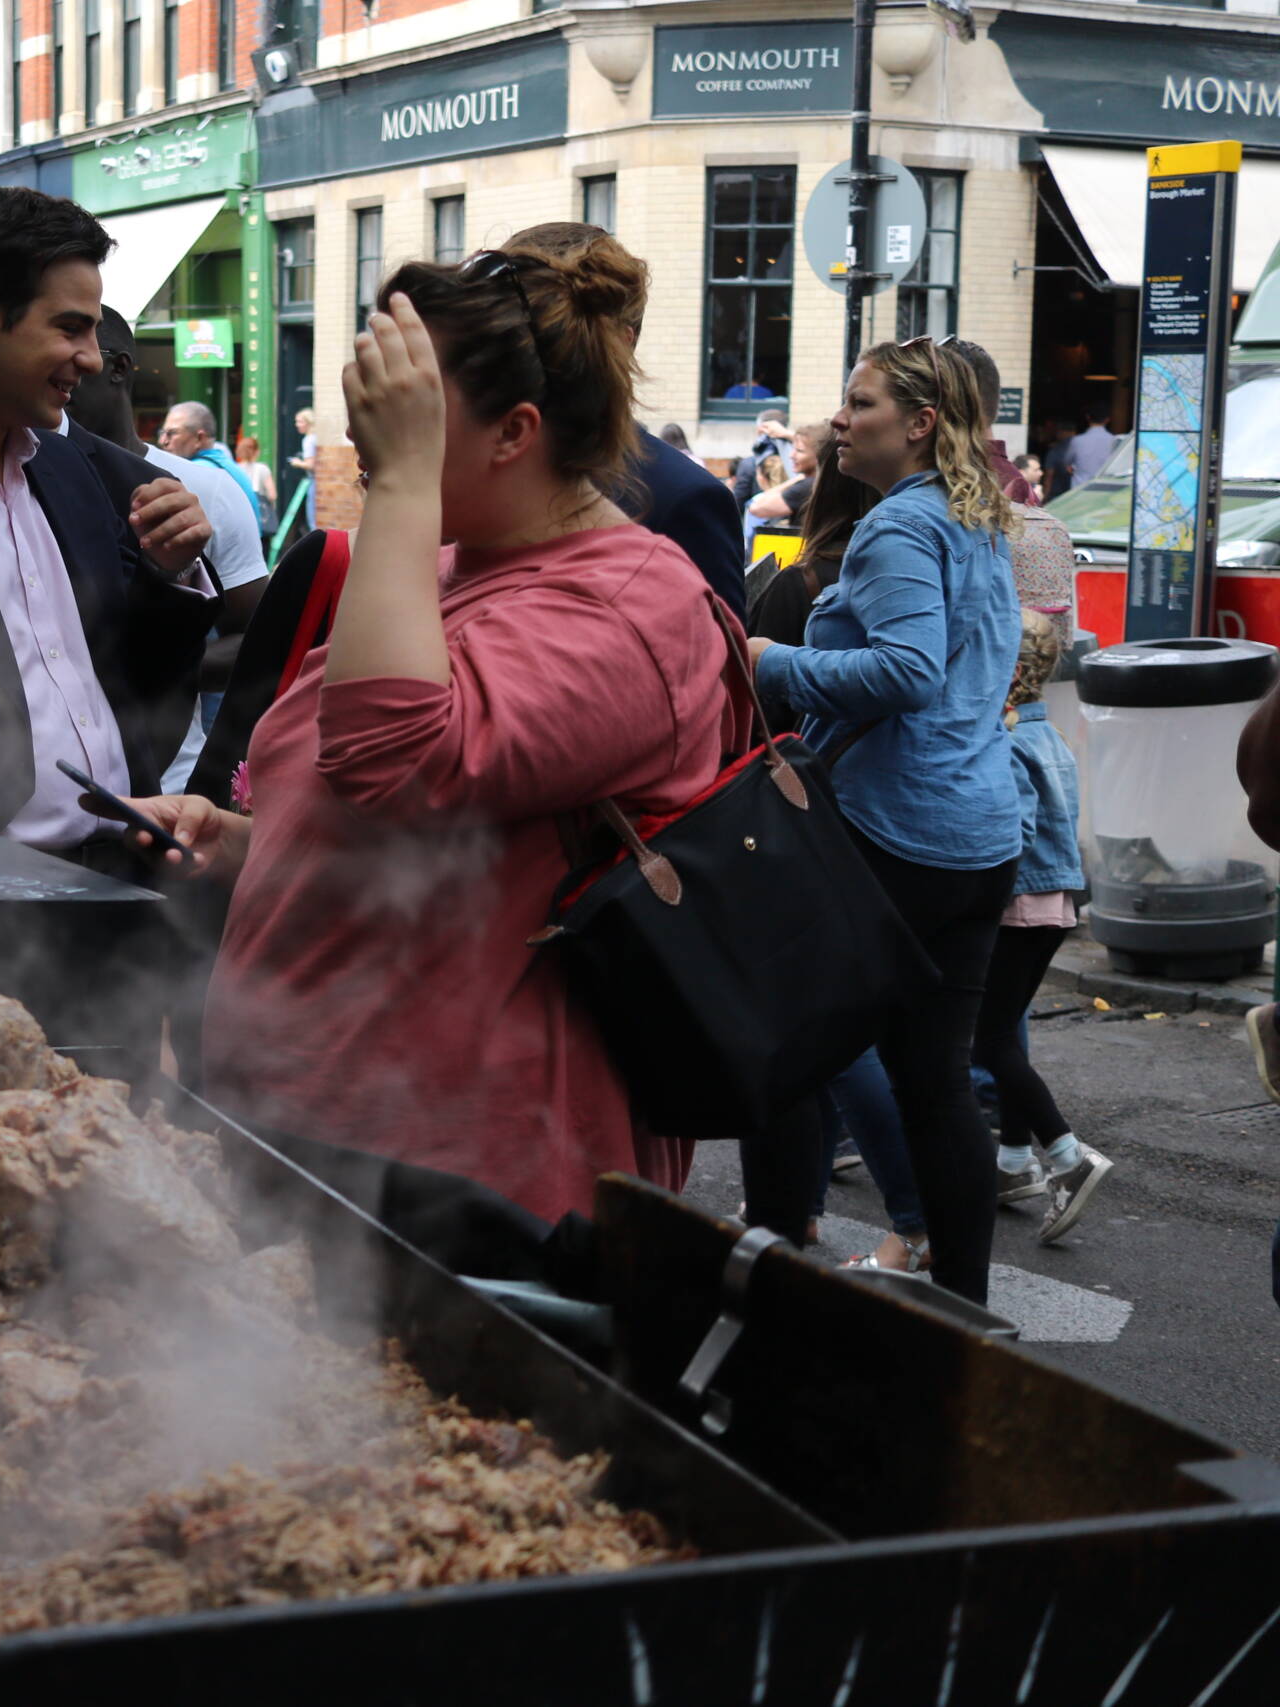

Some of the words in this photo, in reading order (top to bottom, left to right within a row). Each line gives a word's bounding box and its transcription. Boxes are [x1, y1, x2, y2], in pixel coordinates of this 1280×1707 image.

[671, 46, 840, 73] MONMOUTH
[695, 79, 743, 92] COFFEE
[746, 77, 813, 93] COMPANY
[1161, 73, 1280, 117] MONM
[380, 82, 520, 142] MONMOUTH
